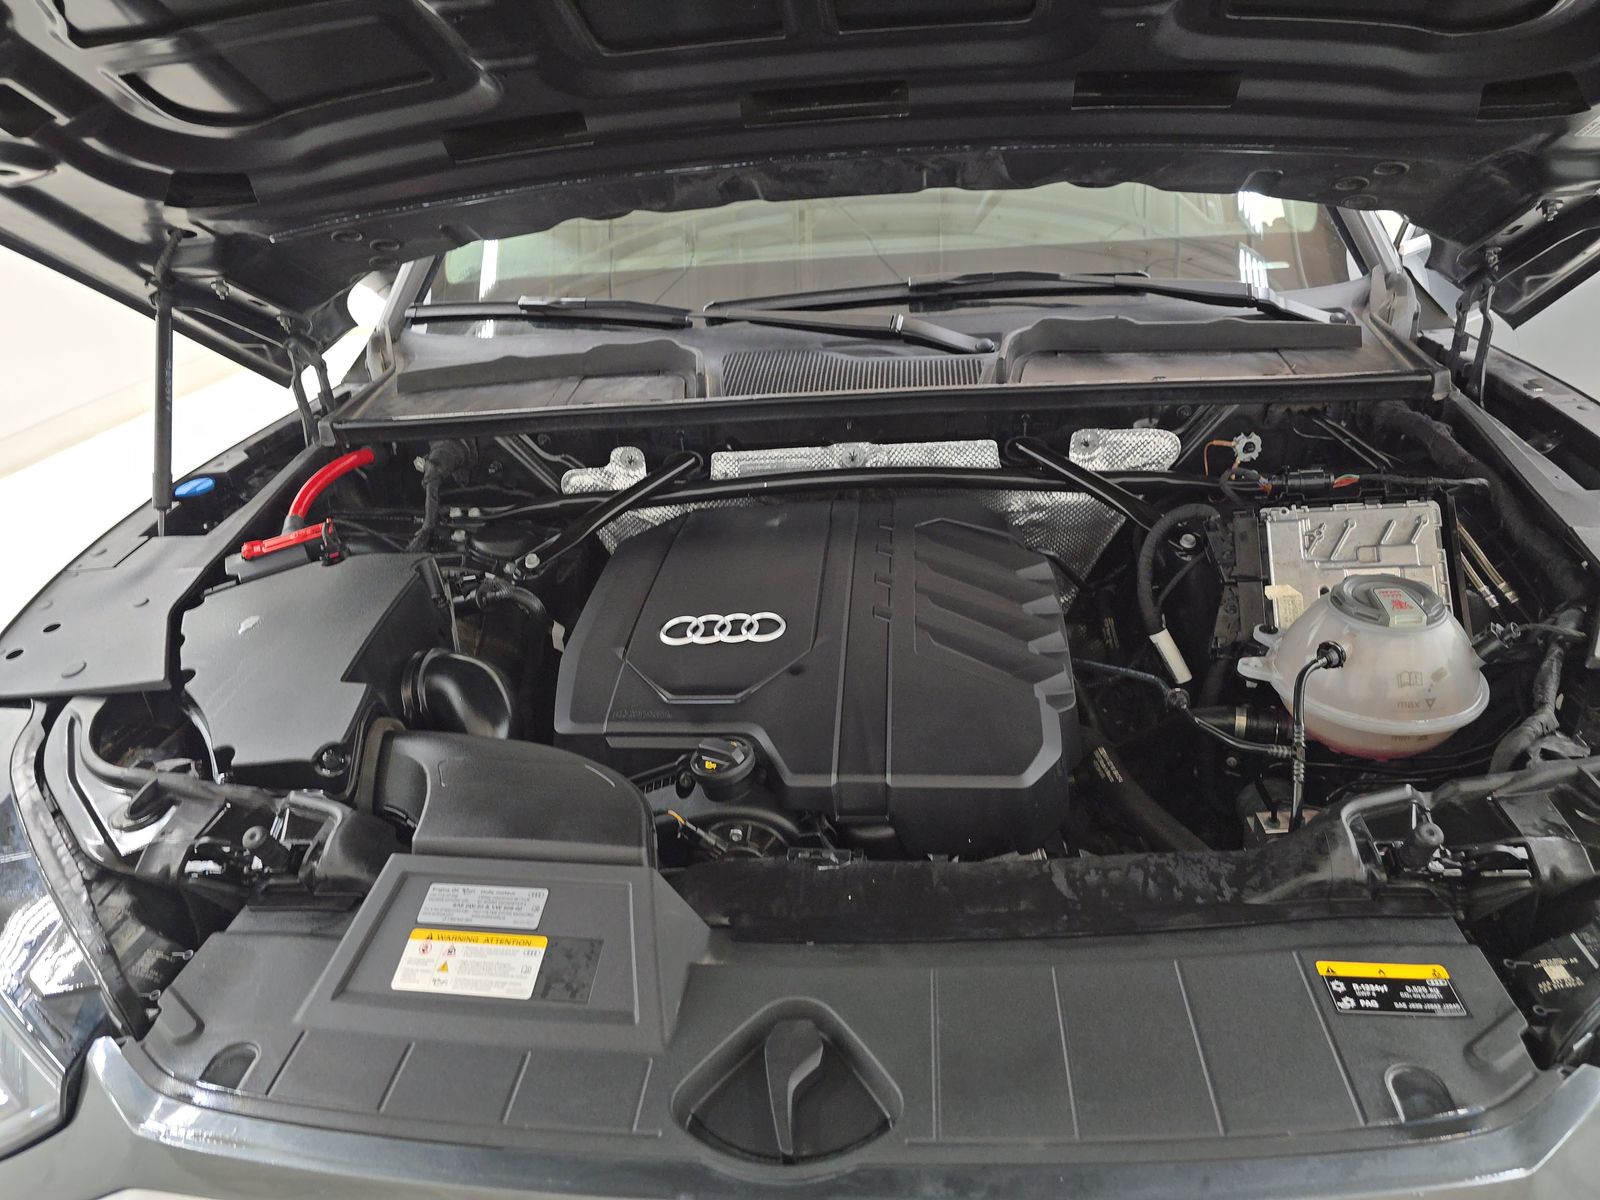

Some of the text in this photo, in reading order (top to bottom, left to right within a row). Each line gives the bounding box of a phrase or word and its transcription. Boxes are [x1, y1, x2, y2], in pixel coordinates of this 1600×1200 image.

[1397, 701, 1420, 709] max
[437, 934, 533, 947] WARNING ATTENTION
[1360, 999, 1379, 1008] PAG
